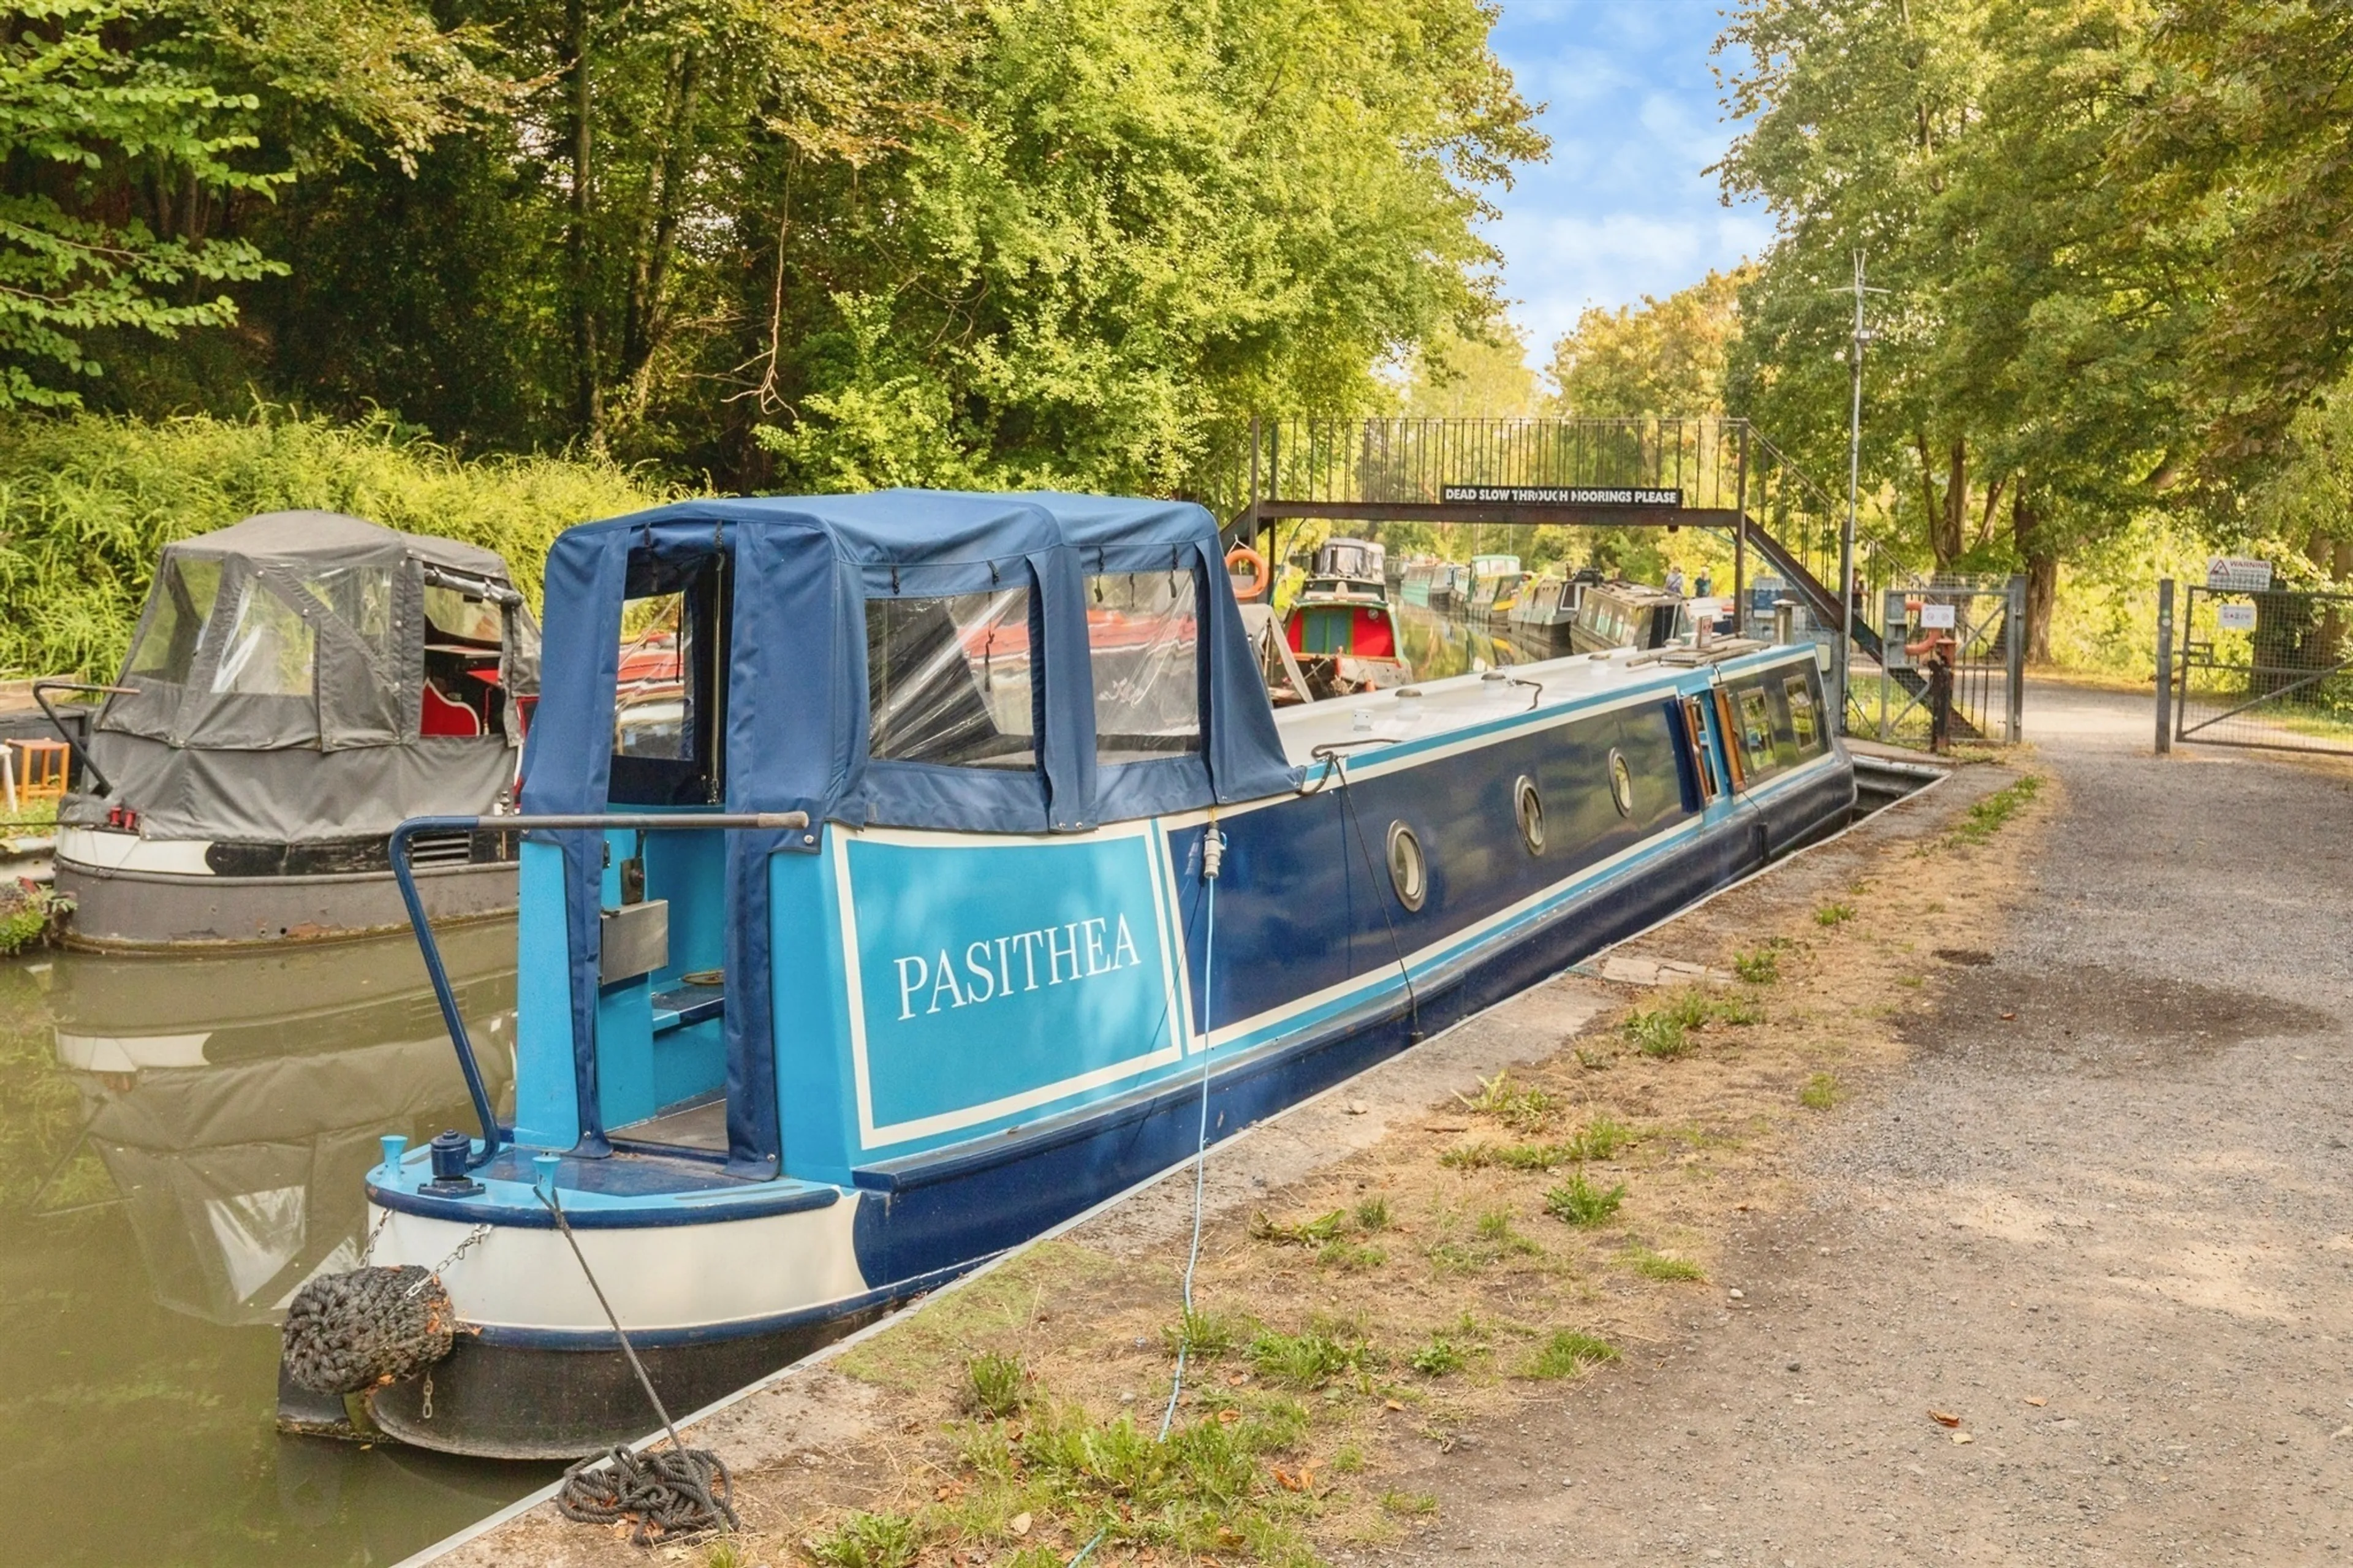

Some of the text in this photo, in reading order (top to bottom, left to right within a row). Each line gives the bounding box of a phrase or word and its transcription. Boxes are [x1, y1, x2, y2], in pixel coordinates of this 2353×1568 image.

[1446, 488, 1477, 500] DEAD
[1479, 489, 1510, 501] SLOW
[1571, 491, 1632, 502] MOORINGS
[1634, 491, 1677, 504] PLEASE
[893, 912, 1142, 1021] PASITHEA
